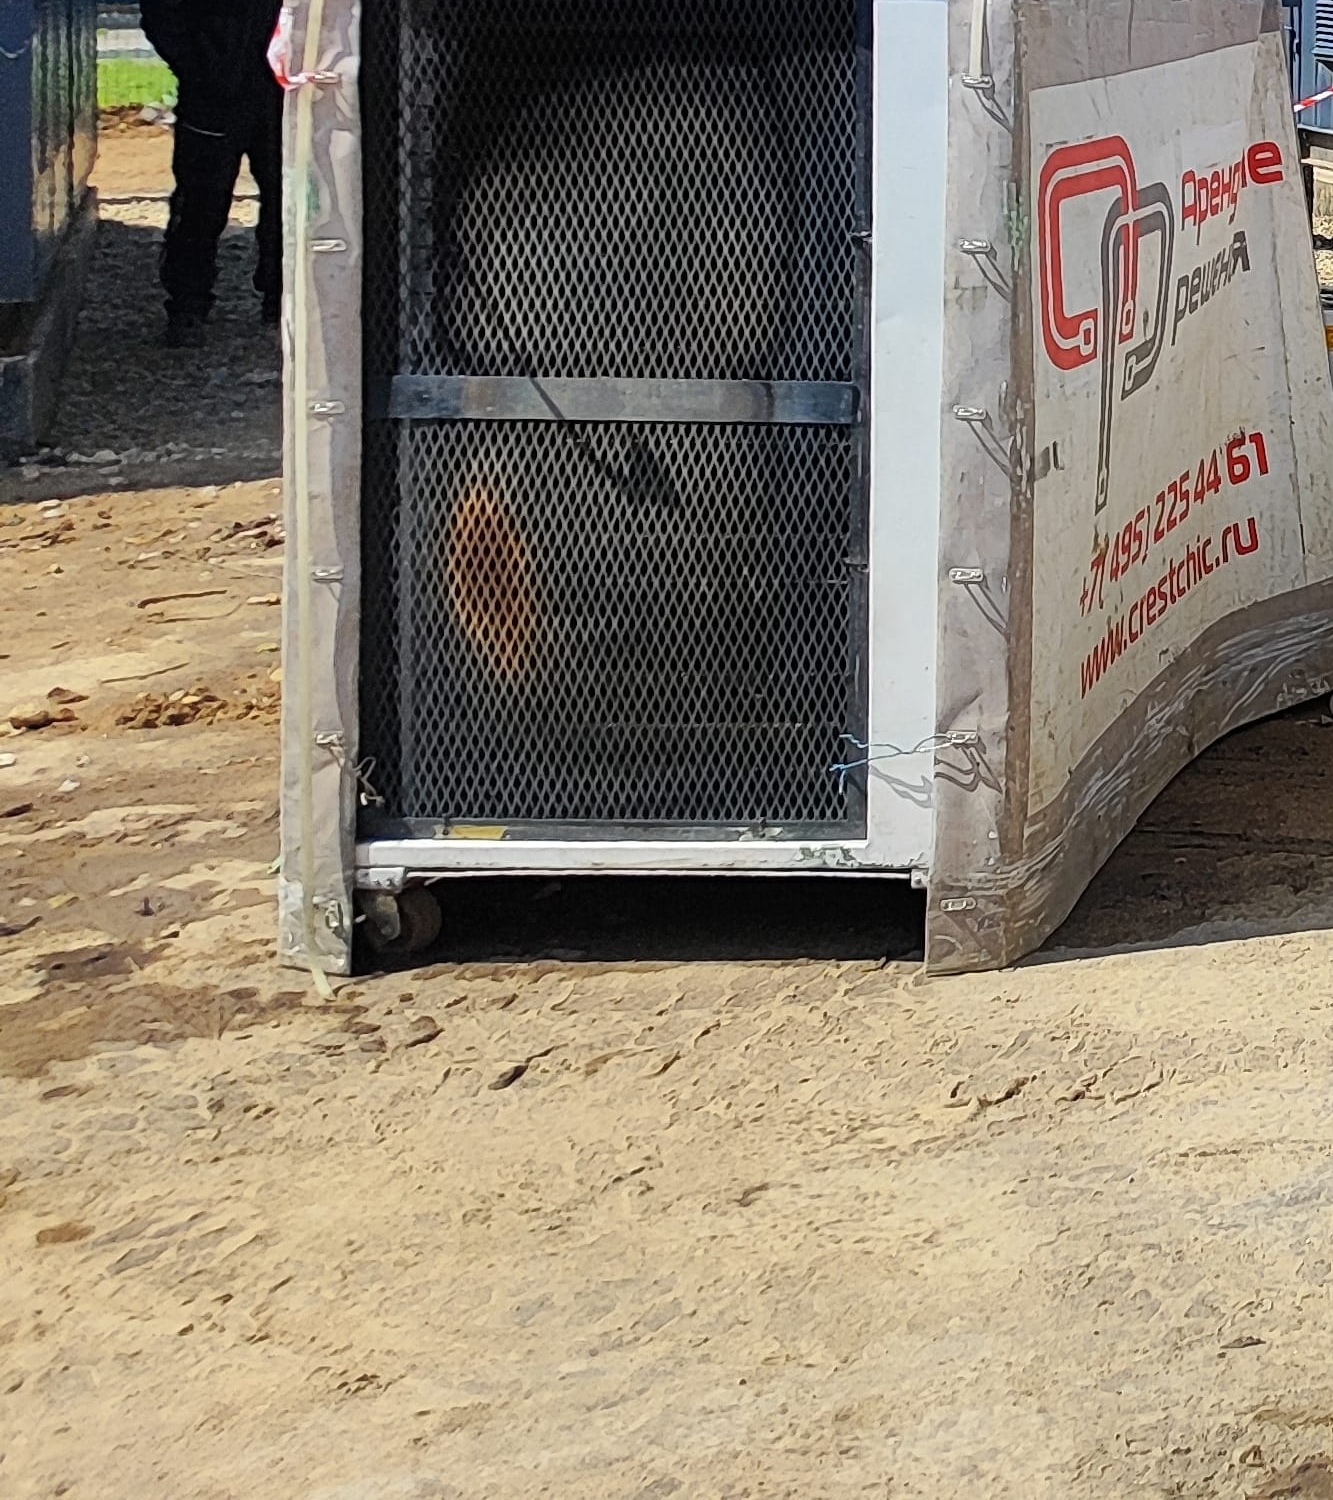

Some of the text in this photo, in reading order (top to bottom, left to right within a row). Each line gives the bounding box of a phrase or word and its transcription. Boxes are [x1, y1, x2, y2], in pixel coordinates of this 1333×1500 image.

[1153, 469, 1191, 545] 225
[1193, 448, 1223, 505] 44
[1226, 431, 1270, 486] 61
[1077, 516, 1260, 700] www.crestchic.ru
